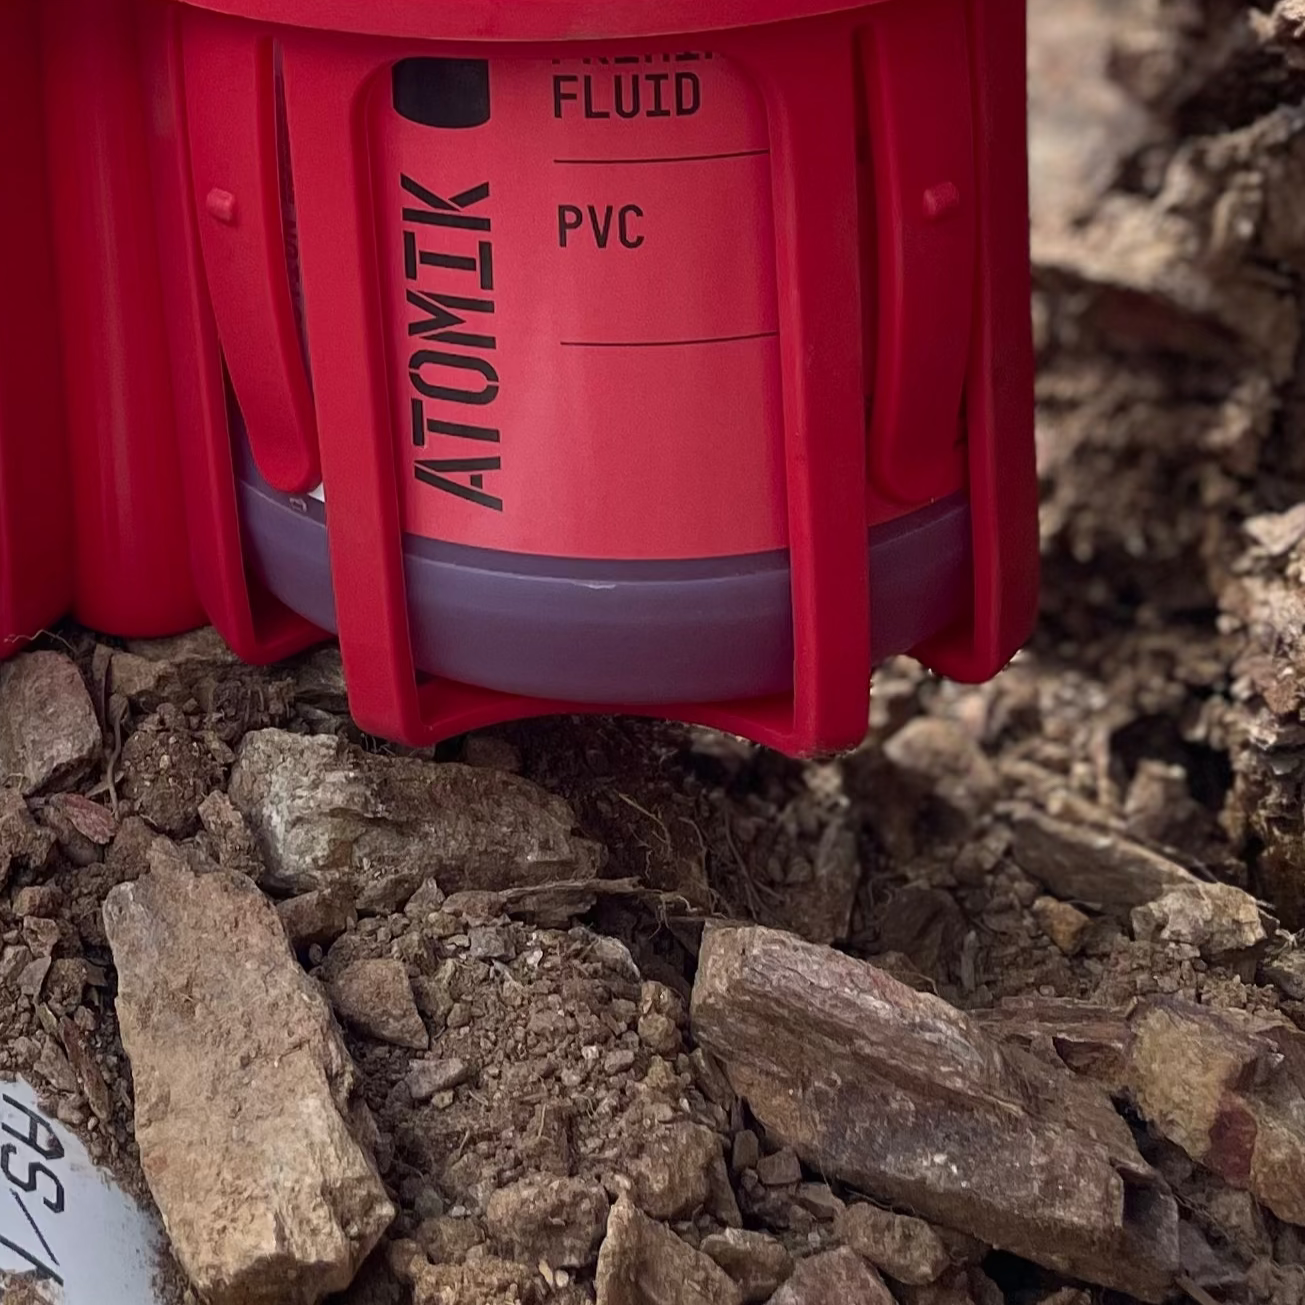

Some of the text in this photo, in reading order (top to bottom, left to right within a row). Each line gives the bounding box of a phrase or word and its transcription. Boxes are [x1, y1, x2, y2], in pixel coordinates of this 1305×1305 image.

[552, 71, 701, 119] FLUID
[557, 203, 646, 249] PVC
[400, 172, 503, 512] ATOMIK
